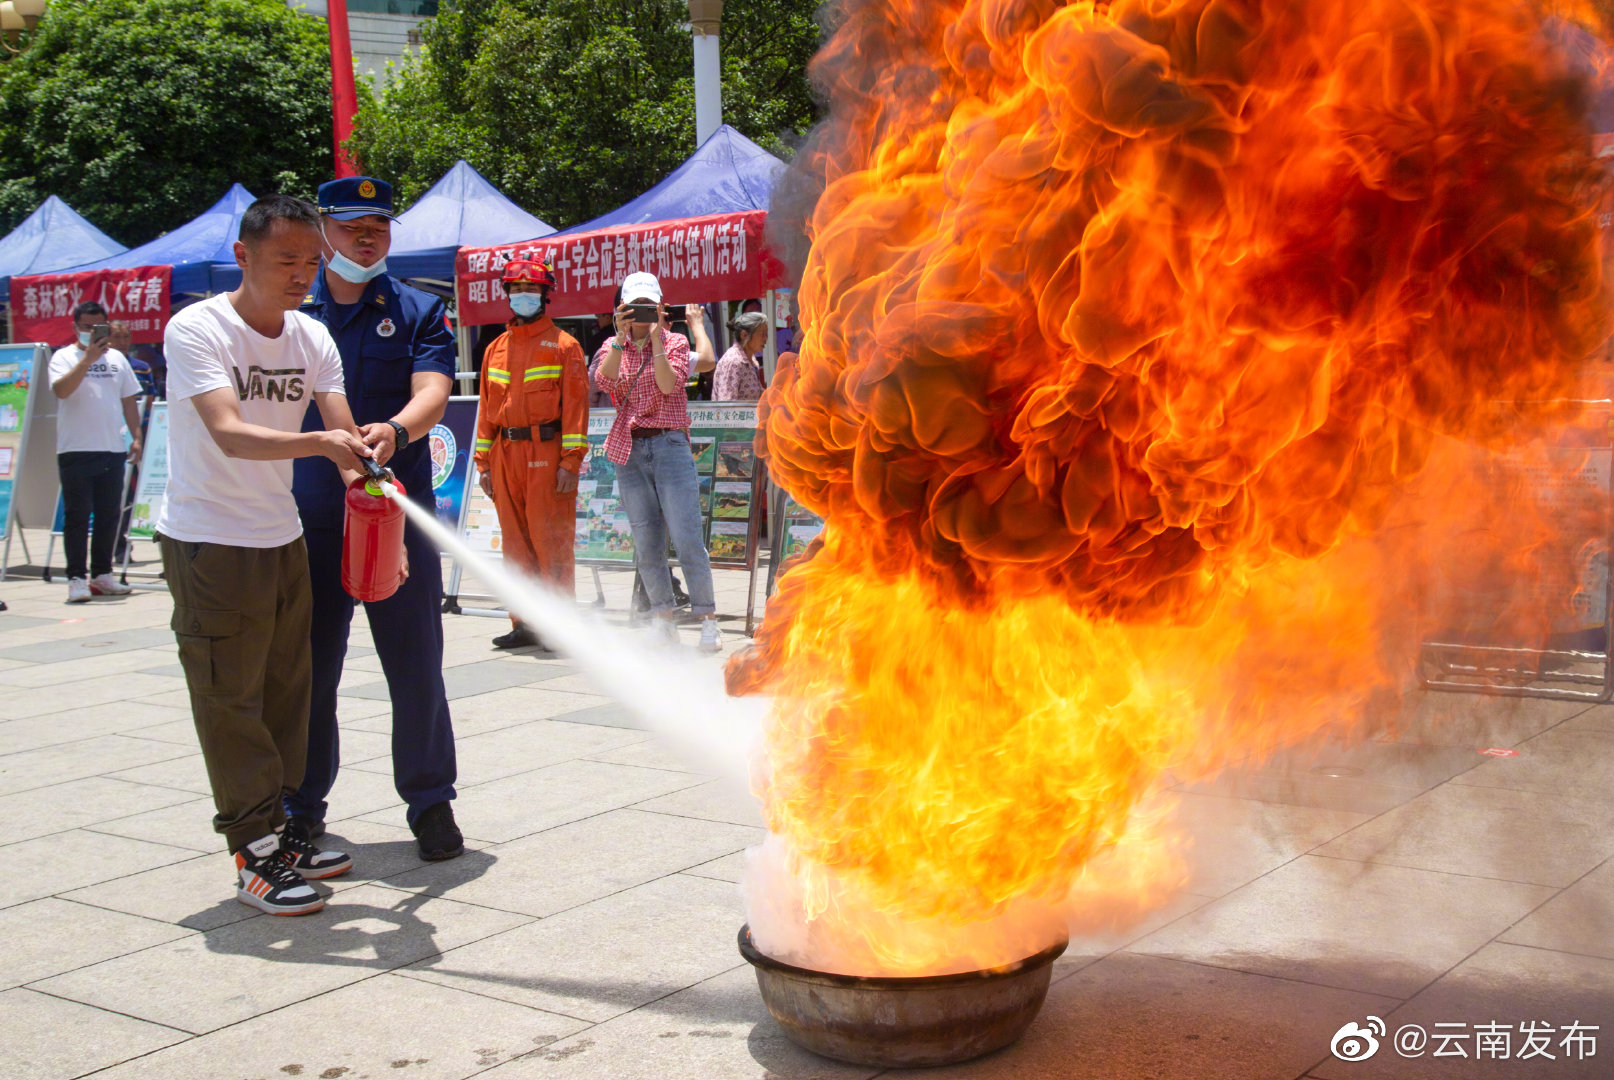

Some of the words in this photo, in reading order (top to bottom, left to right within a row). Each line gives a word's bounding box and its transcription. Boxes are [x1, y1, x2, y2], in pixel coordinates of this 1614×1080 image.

[99, 276, 163, 313] 人人有责
[232, 365, 306, 402] VANS
[254, 840, 274, 852] adidas
